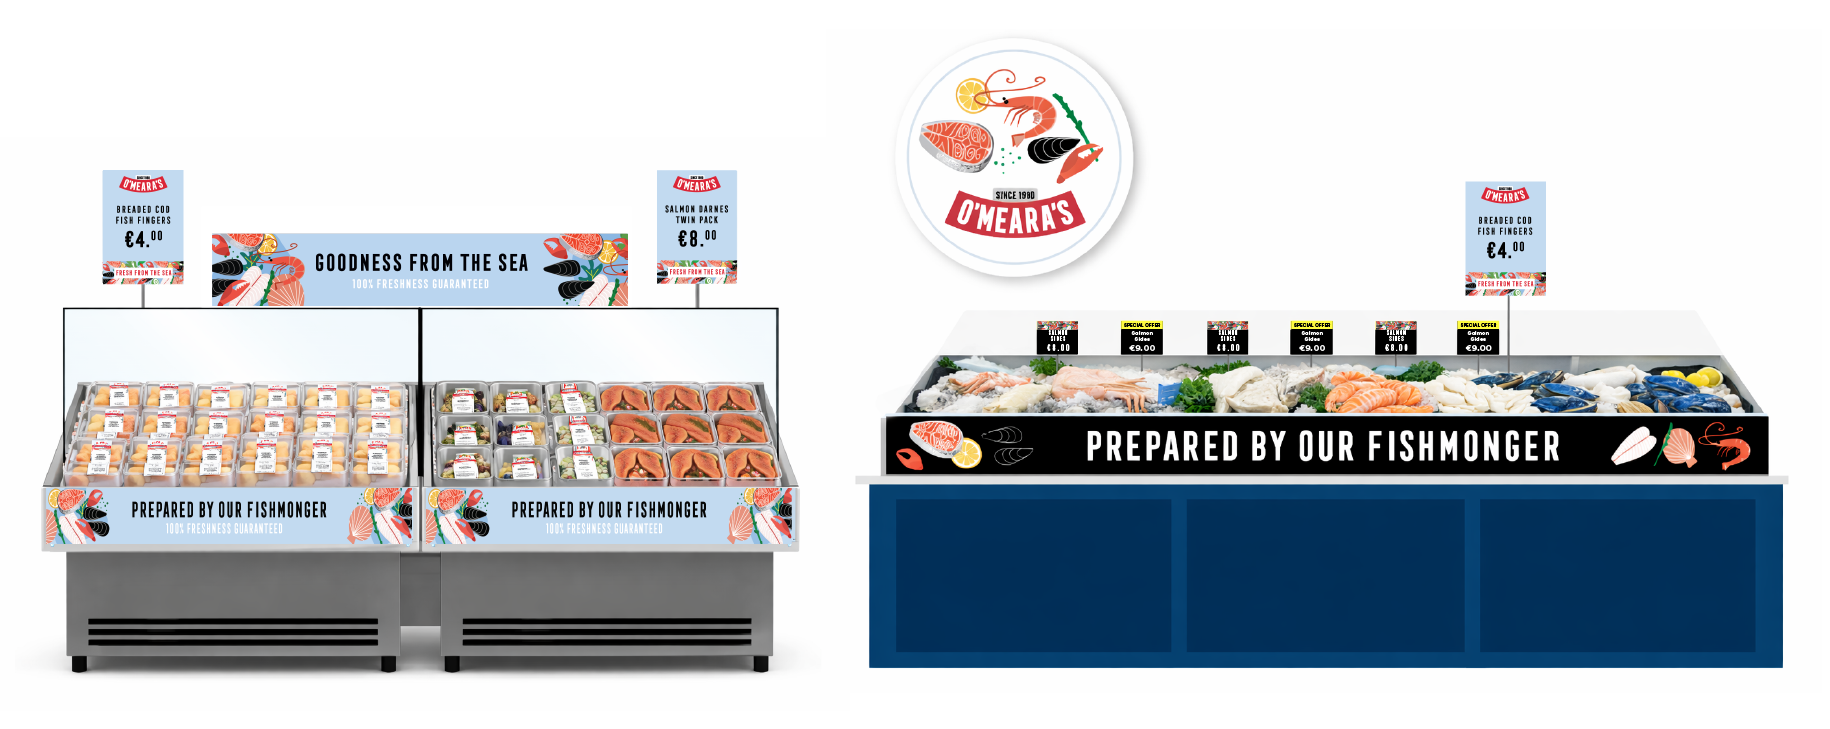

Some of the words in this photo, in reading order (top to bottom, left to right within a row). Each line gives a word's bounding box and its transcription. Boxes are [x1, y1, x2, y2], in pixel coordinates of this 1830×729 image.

[123, 179, 163, 191] O'MEARA'S
[677, 179, 717, 191] O'MEARA'S
[996, 191, 1016, 199] SINCE
[1018, 191, 1035, 199] 1980
[1485, 190, 1525, 202] O'MEARA'S
[665, 205, 695, 213] SALMON
[699, 205, 729, 213] DARNES
[957, 199, 1074, 234] O'MEARA'S
[315, 253, 402, 272] GOODNESS
[409, 253, 453, 272] FROM
[460, 253, 492, 272] THE
[498, 253, 529, 272] SEA
[352, 279, 373, 289] 100%
[377, 279, 429, 289] FRESHNESS
[432, 279, 490, 289] GUARANTEED
[1086, 430, 1244, 463] PREPARED
[1250, 430, 1286, 463] BY
[1297, 430, 1355, 463] OUR
[1368, 430, 1561, 463] FISHMONGER
[131, 501, 194, 518] PREPARED
[199, 501, 213, 518] BY
[218, 501, 242, 518] OUR
[247, 501, 327, 518] FISHMONGER
[511, 501, 574, 518] PREPARED
[579, 501, 593, 518] BY
[598, 501, 622, 518] OUR
[627, 501, 707, 518] FISHMONGER
[166, 523, 184, 534] 100%
[187, 523, 232, 534] FRESHNESS
[234, 523, 284, 534] GUARANTEED
[546, 523, 564, 534] 100%
[567, 523, 612, 534] FRESHNESS
[614, 523, 664, 534] GUARANTEED
